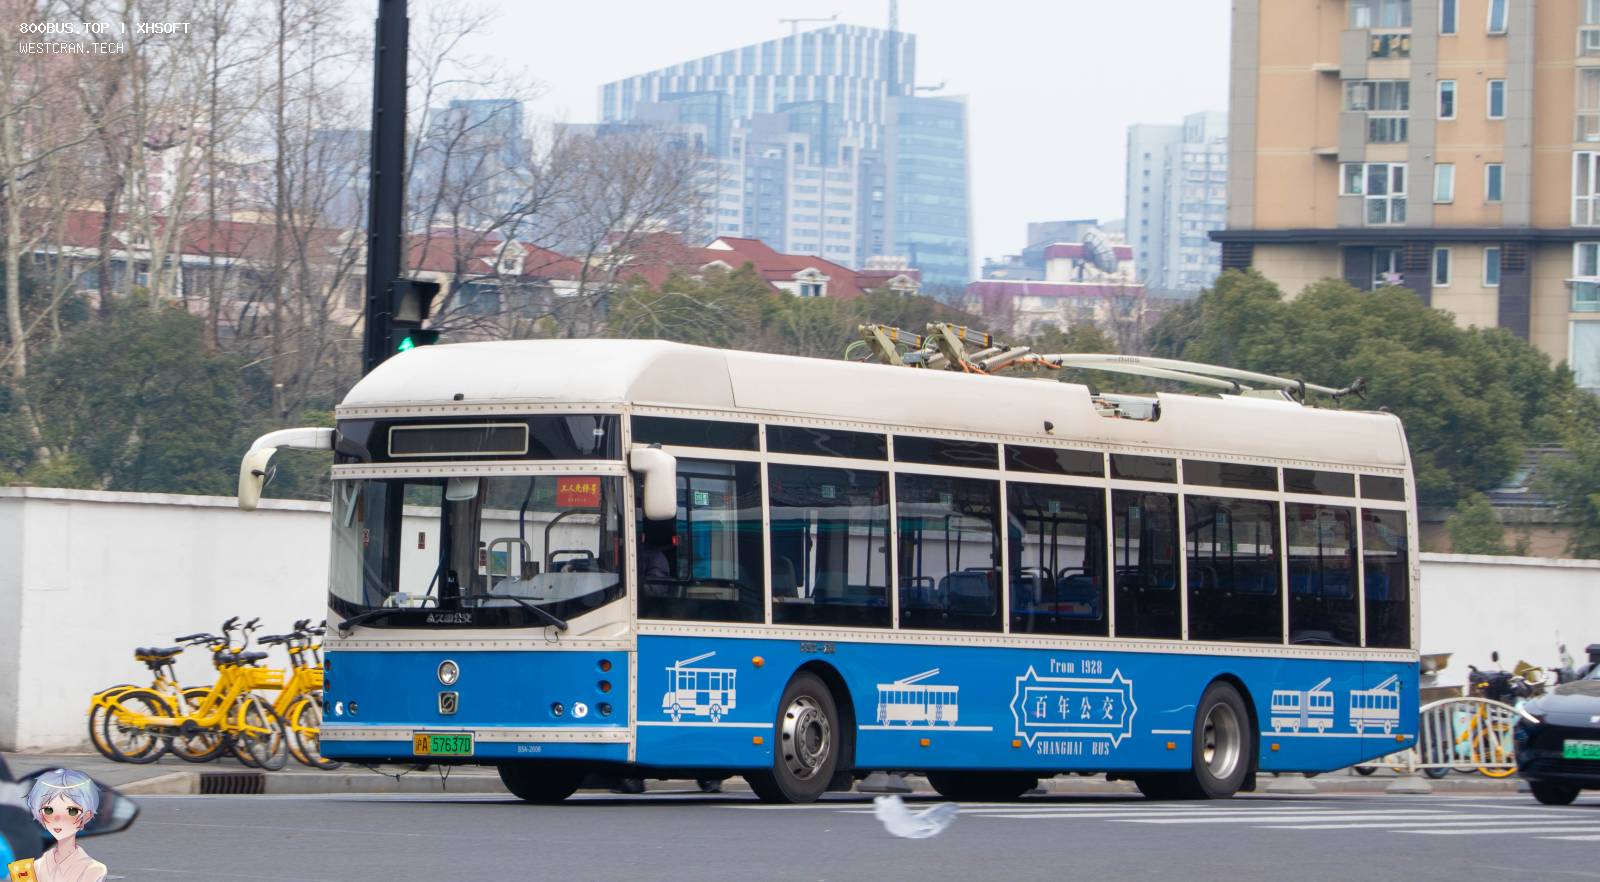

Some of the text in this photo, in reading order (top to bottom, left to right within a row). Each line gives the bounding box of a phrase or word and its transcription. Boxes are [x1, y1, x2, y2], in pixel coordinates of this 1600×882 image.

[1050, 658, 1103, 675] From 1928
[1035, 695, 1114, 721] 百年公交
[433, 737, 471, 752] 57637D
[1037, 740, 1110, 756] SHANGHAI BUS
